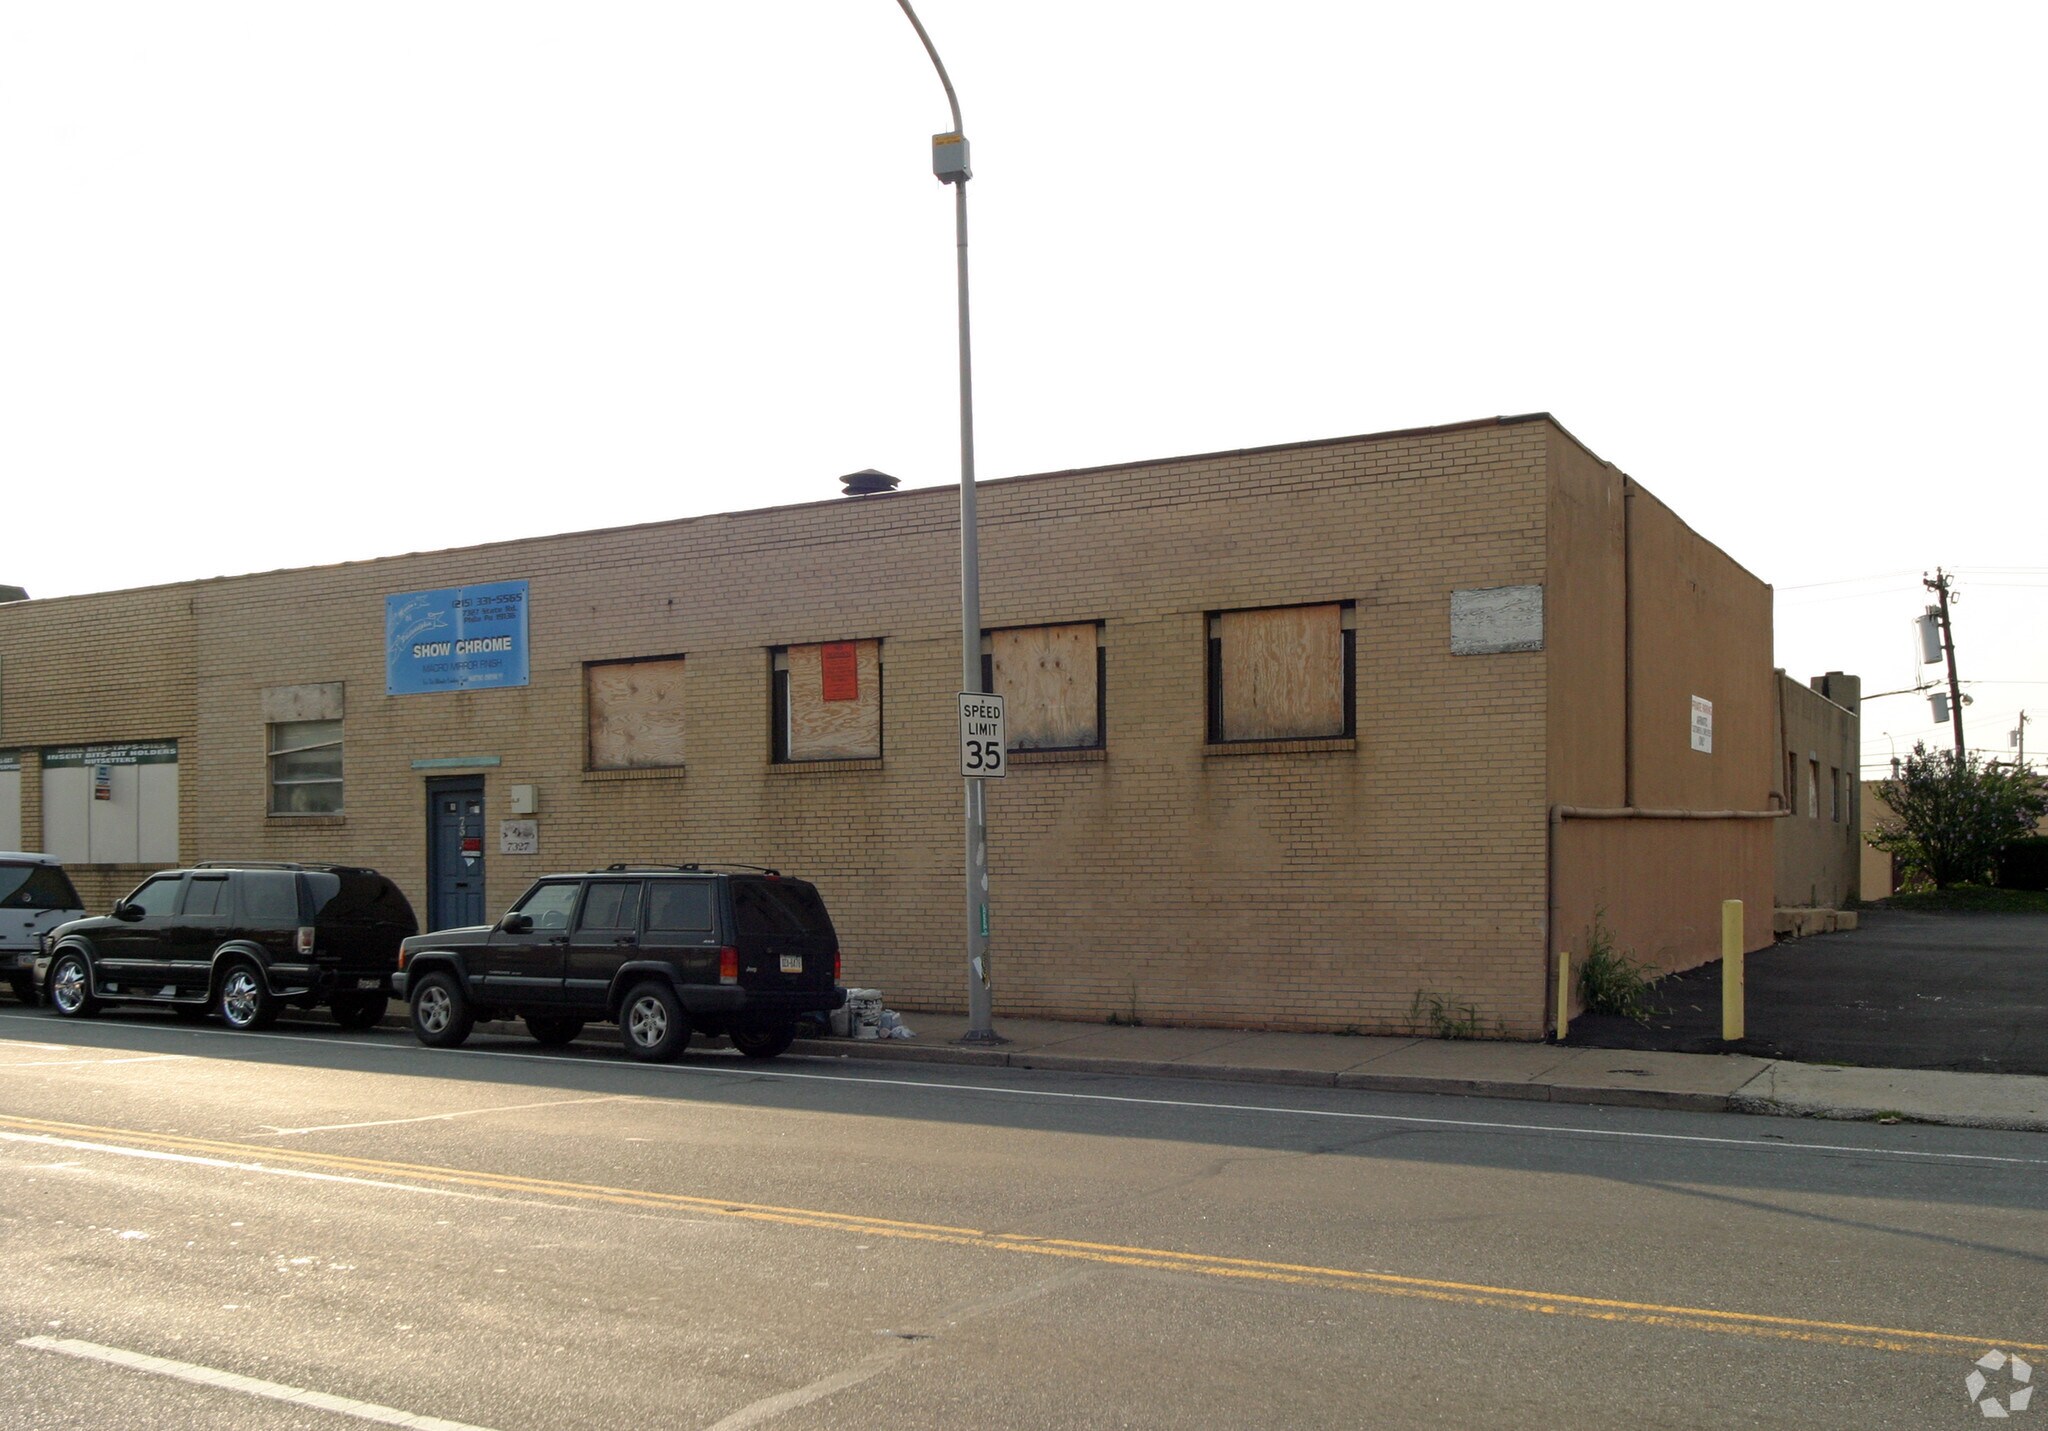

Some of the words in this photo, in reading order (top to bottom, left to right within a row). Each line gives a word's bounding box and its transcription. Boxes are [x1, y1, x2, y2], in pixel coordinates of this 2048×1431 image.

[452, 598, 472, 608] (215)
[477, 593, 522, 606] 331-5565
[413, 641, 451, 658] SHOW
[456, 636, 512, 654] CHROME
[964, 704, 1000, 719] SPEED
[968, 722, 997, 736] LIMIT
[85, 750, 127, 759] BITS-BIT
[130, 748, 177, 756] HOLDERS
[966, 740, 1000, 770] 35
[507, 842, 530, 851] 7327
